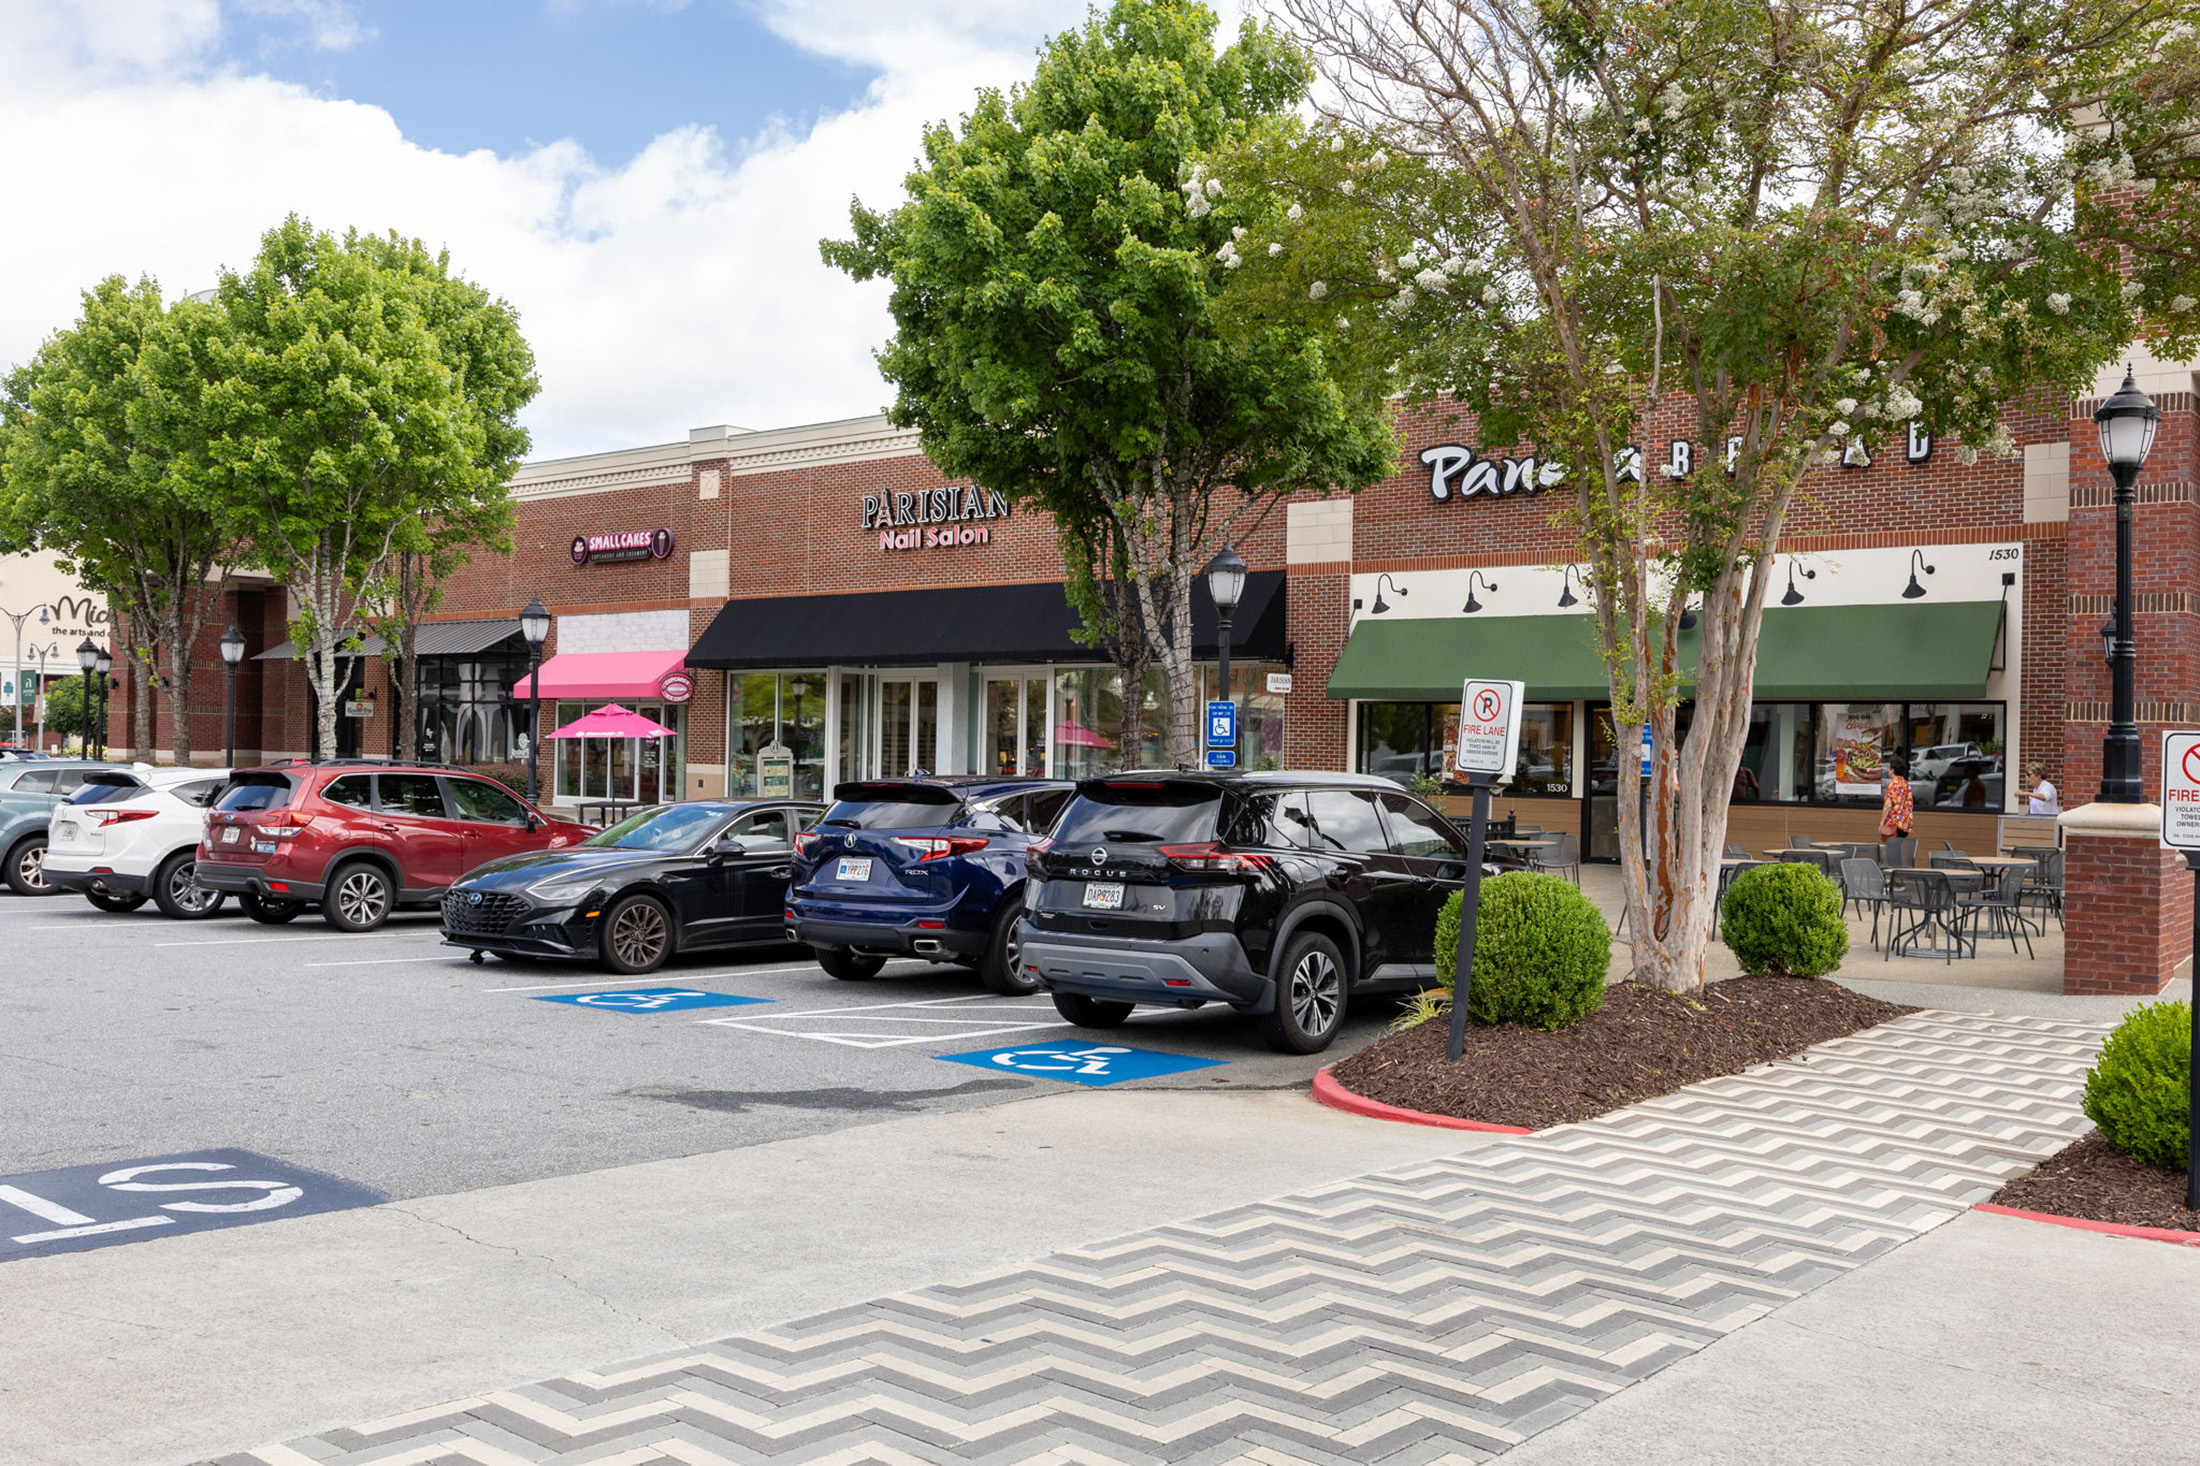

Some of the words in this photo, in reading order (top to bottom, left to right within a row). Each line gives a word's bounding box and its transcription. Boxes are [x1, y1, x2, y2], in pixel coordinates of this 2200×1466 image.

[1419, 444, 1645, 500] Panea
[861, 485, 1009, 528] PARISIAN
[589, 531, 651, 550] SMALLCAKES
[880, 528, 921, 550] Nail
[927, 525, 989, 547] Salon
[1989, 548, 2019, 560] 1530
[50, 596, 108, 628] Mic
[52, 627, 67, 635] the
[88, 629, 105, 637] and
[1463, 724, 1482, 735] FIRE
[1483, 725, 1505, 737] LANE
[1547, 784, 1568, 792] 1530
[2169, 789, 2200, 802] FIRE
[1069, 868, 1127, 878] ROGUE
